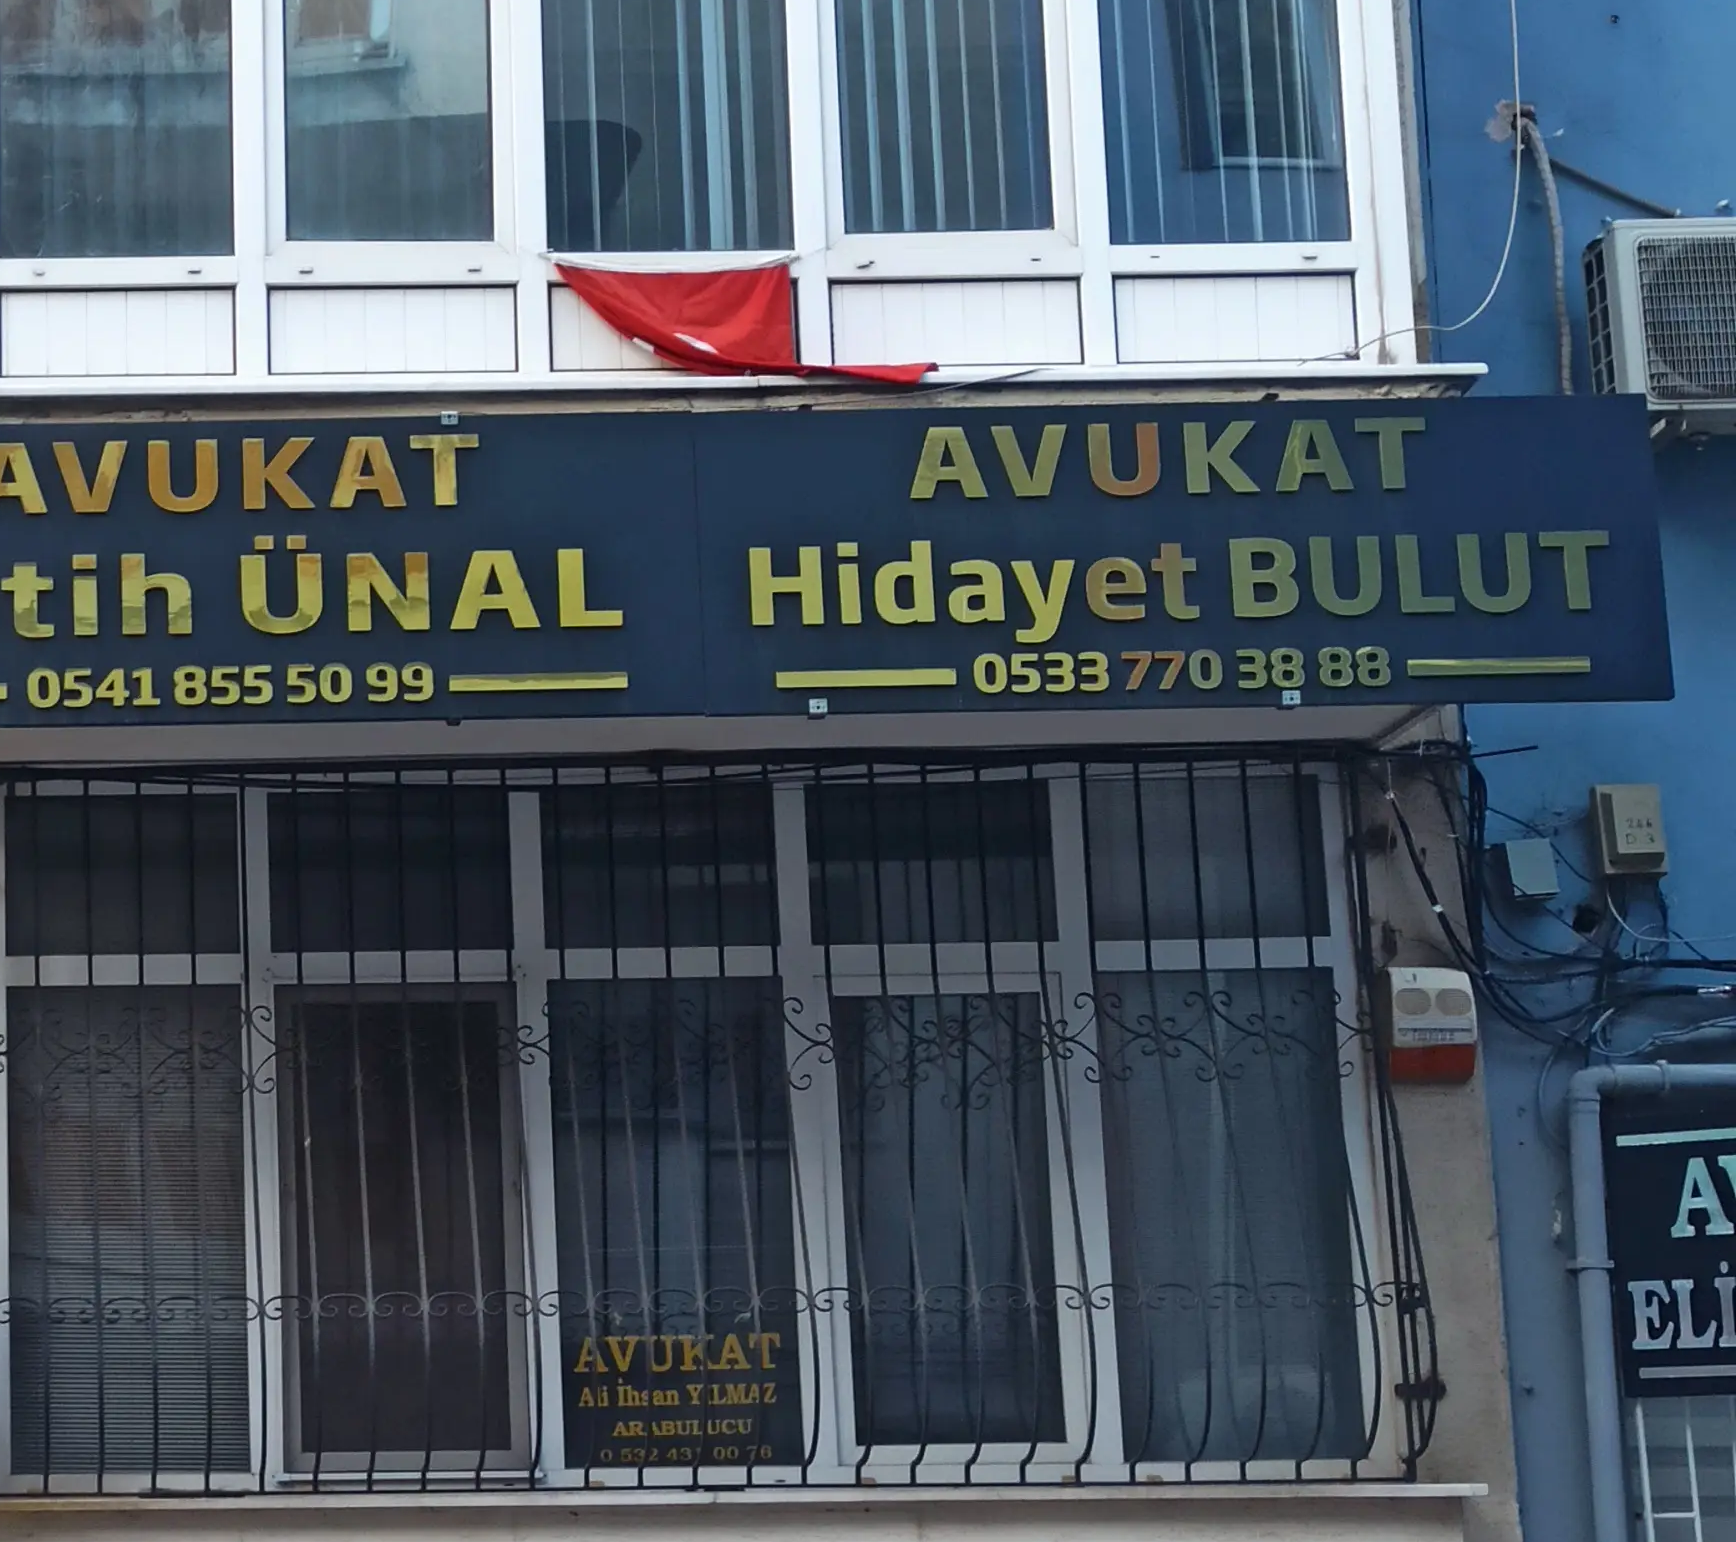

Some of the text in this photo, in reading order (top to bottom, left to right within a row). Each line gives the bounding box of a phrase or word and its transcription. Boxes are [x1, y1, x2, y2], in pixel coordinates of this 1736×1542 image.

[909, 416, 1427, 500] AVUKAT
[239, 534, 624, 635] ÜNAL
[747, 529, 1610, 644] Hidayet BULUT
[26, 662, 435, 710] 0541 855 50 99
[972, 646, 1393, 695] 0533 770 38 88
[573, 1332, 782, 1374] AVUKAT
